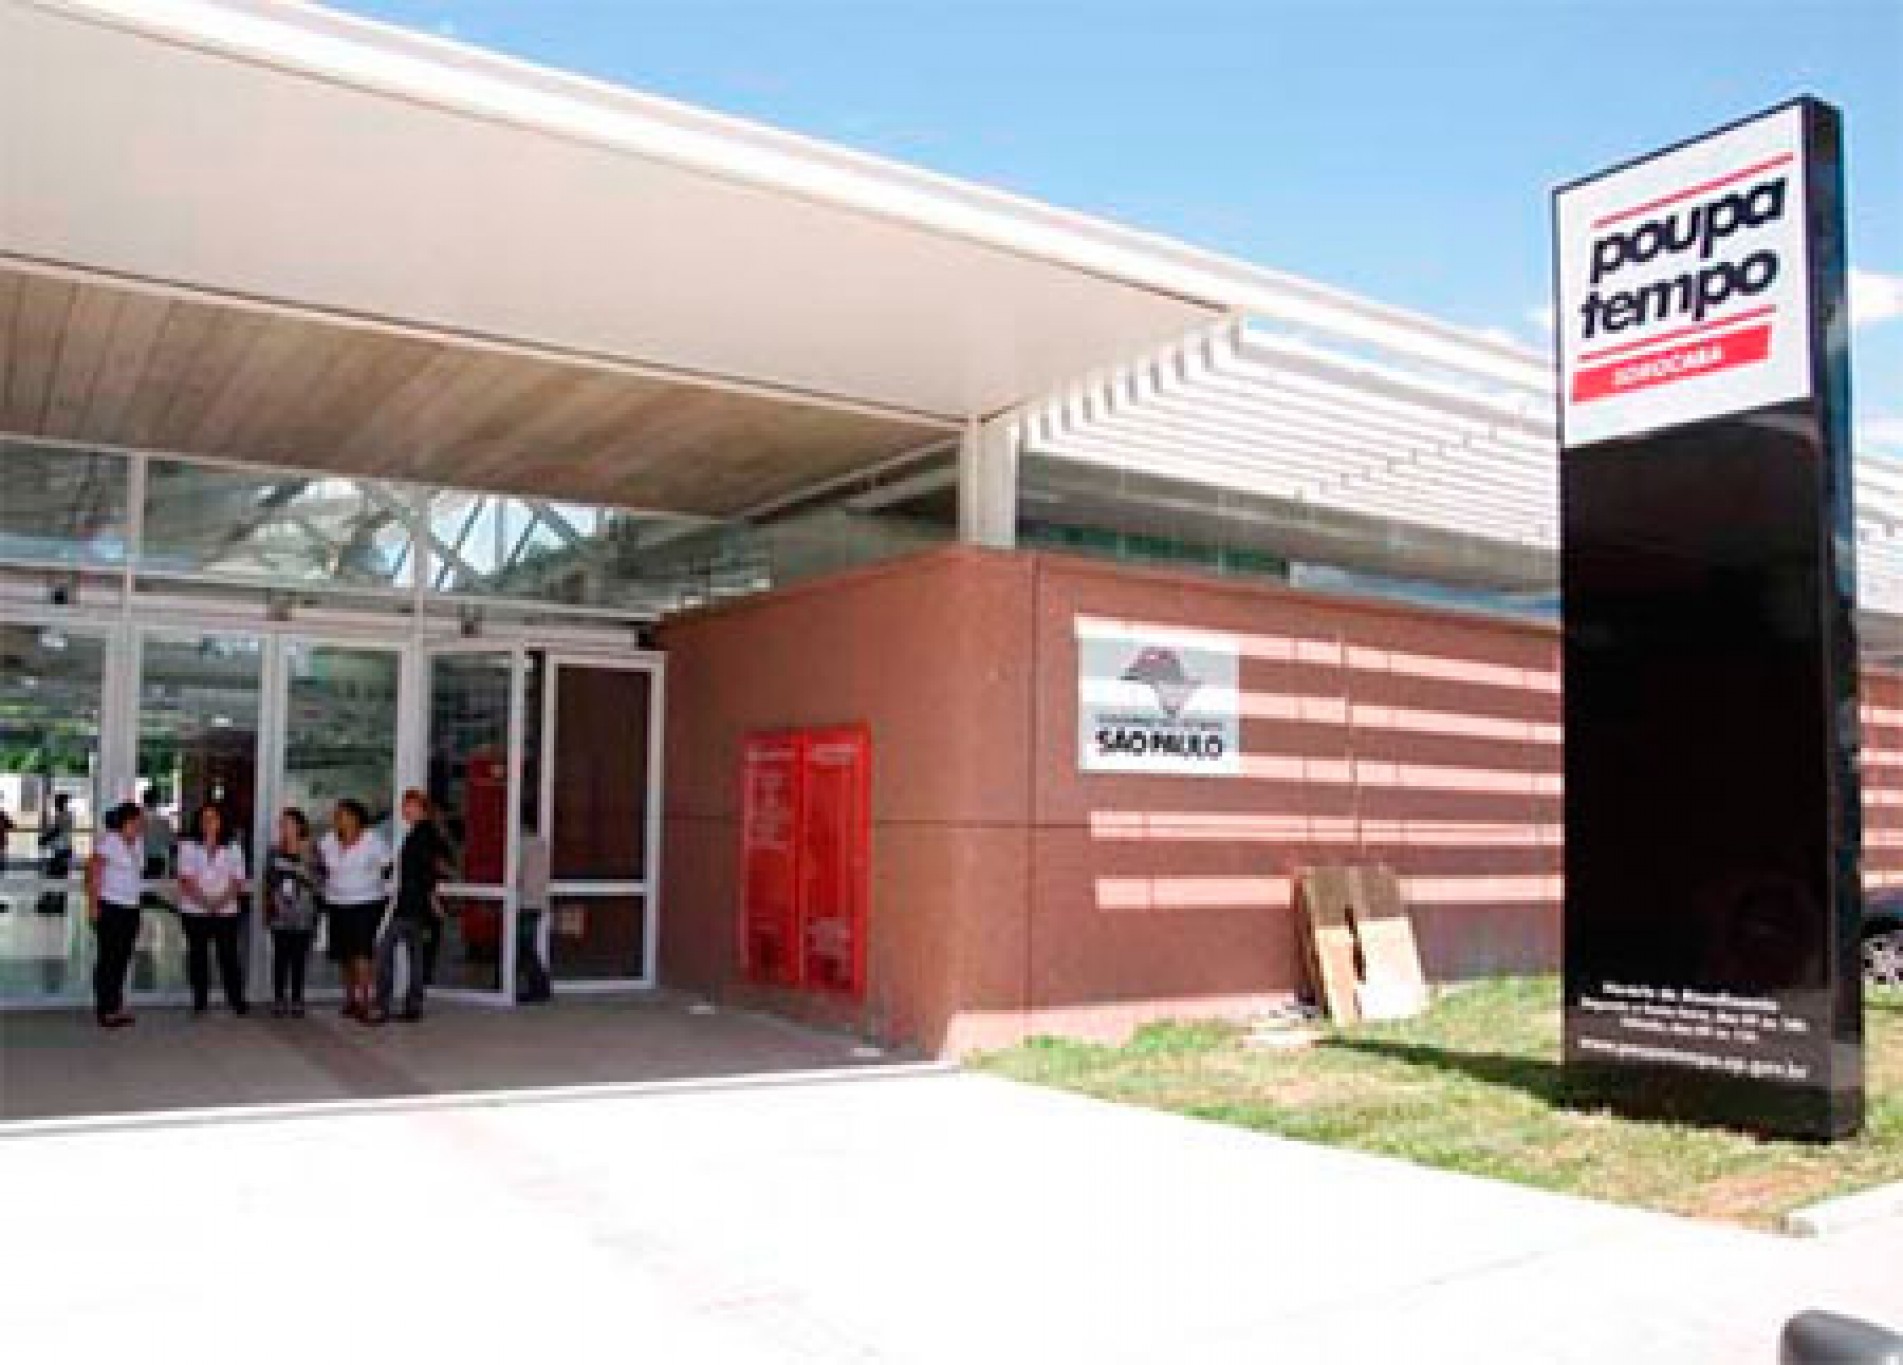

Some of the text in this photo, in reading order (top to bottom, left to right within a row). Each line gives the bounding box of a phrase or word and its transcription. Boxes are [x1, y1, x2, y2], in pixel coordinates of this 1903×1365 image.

[1590, 177, 1786, 284] poupa
[1579, 249, 1778, 338] tempo
[1151, 732, 1223, 761] PAULO
